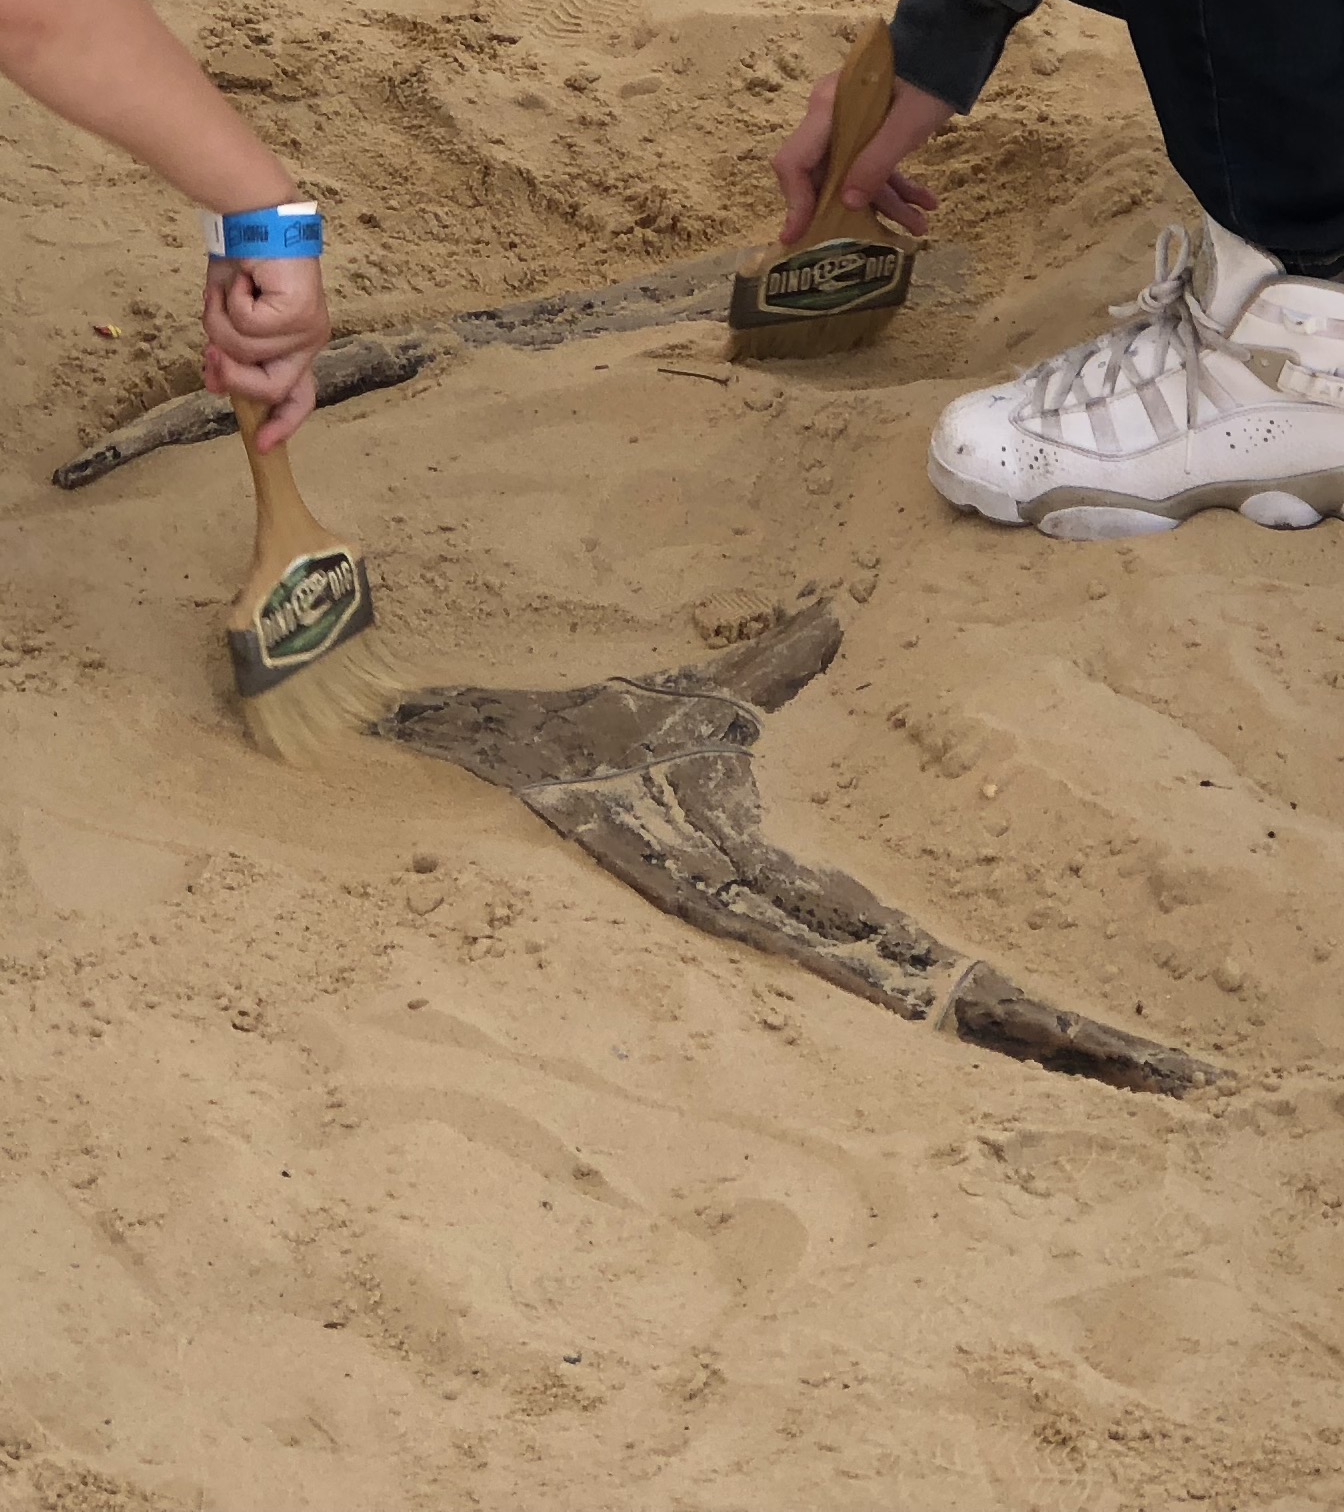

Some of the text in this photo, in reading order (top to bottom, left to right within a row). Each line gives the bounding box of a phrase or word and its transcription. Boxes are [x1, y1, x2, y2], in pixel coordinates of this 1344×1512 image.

[768, 253, 896, 295] DINO DIG
[261, 560, 352, 648] DINO DIG
